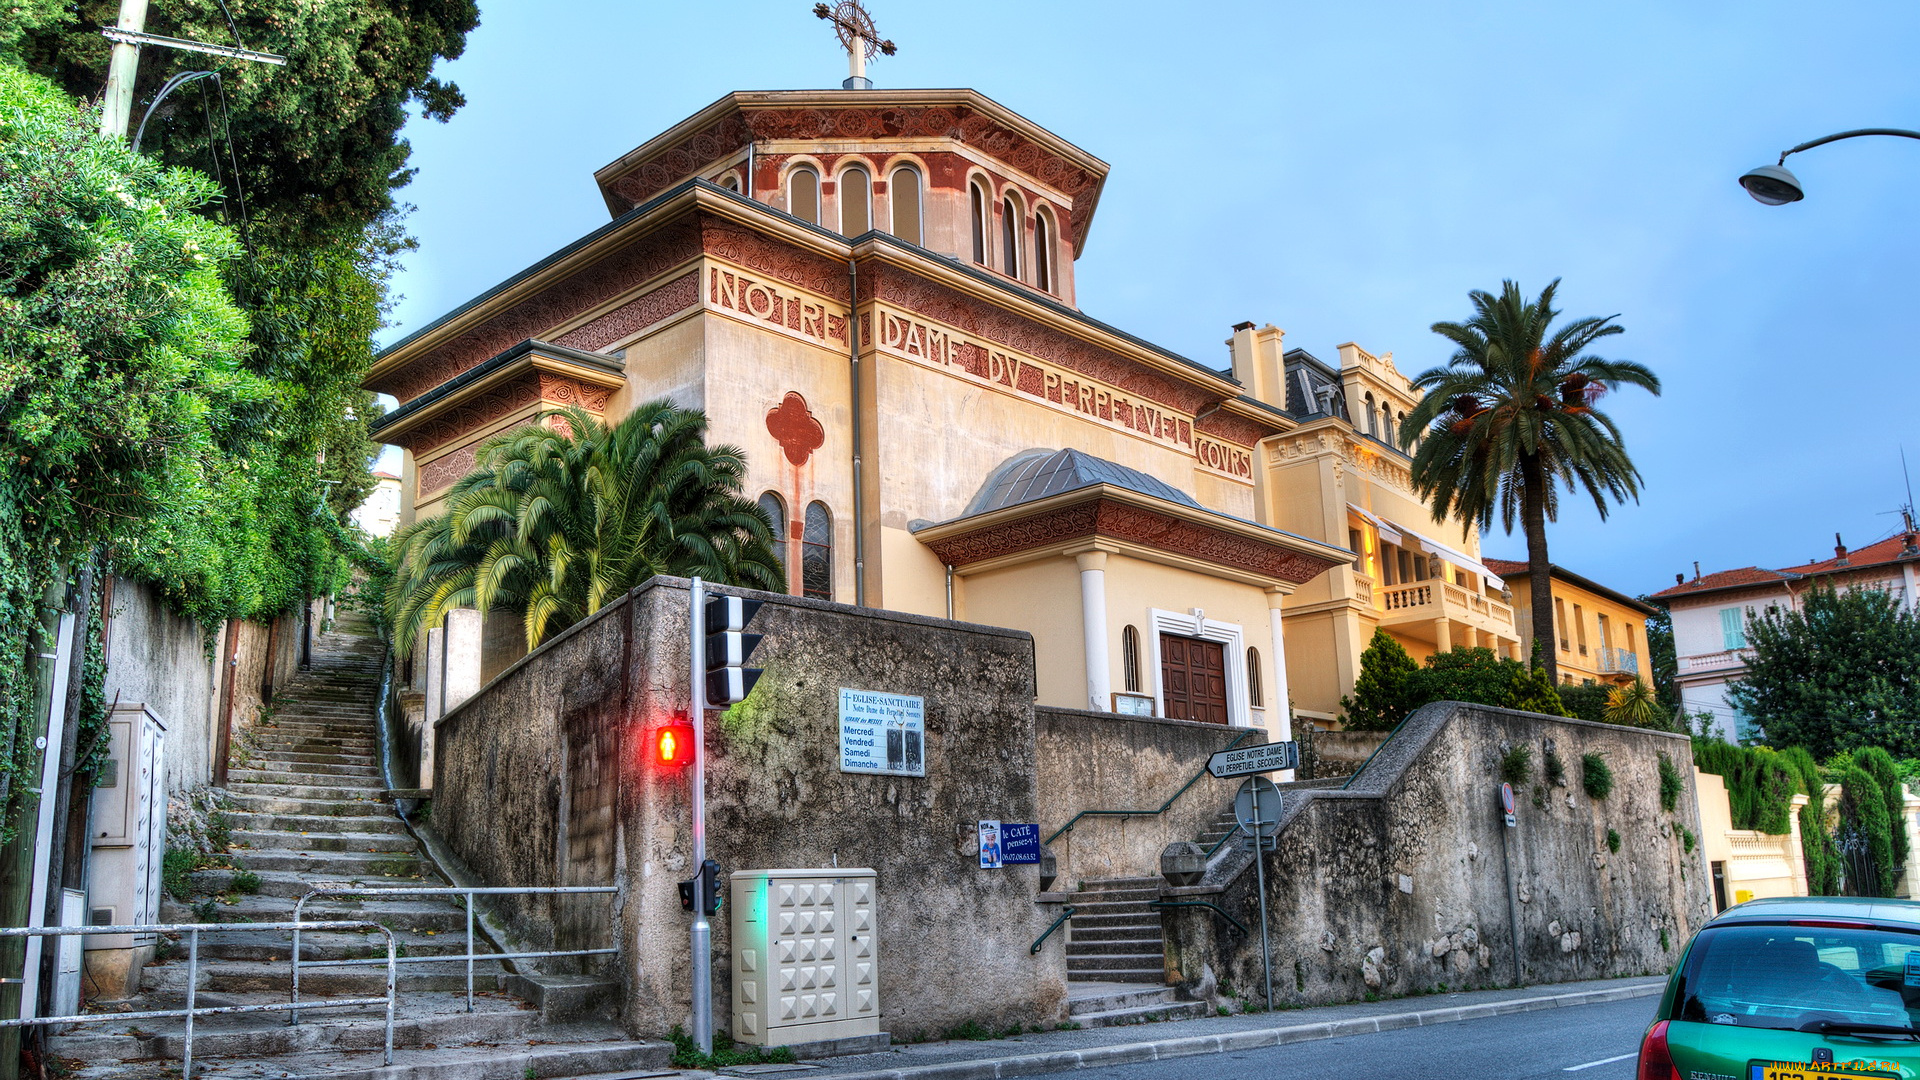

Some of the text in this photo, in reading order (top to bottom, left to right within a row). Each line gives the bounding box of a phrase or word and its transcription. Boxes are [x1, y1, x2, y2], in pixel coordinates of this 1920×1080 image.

[717, 267, 845, 346] NOTRE
[885, 310, 966, 372] DAME
[852, 694, 921, 709] EGLISE-SANCTUAIRE
[844, 726, 874, 736] Mercredi
[844, 737, 874, 747] Vendredi
[845, 748, 870, 757] Samedi
[1226, 746, 1282, 763] EGLISE NOTRE DAME
[845, 759, 878, 769] Dimanche
[1216, 756, 1284, 774] DU PERPETUEL SECOURS
[1002, 829, 1009, 839] le
